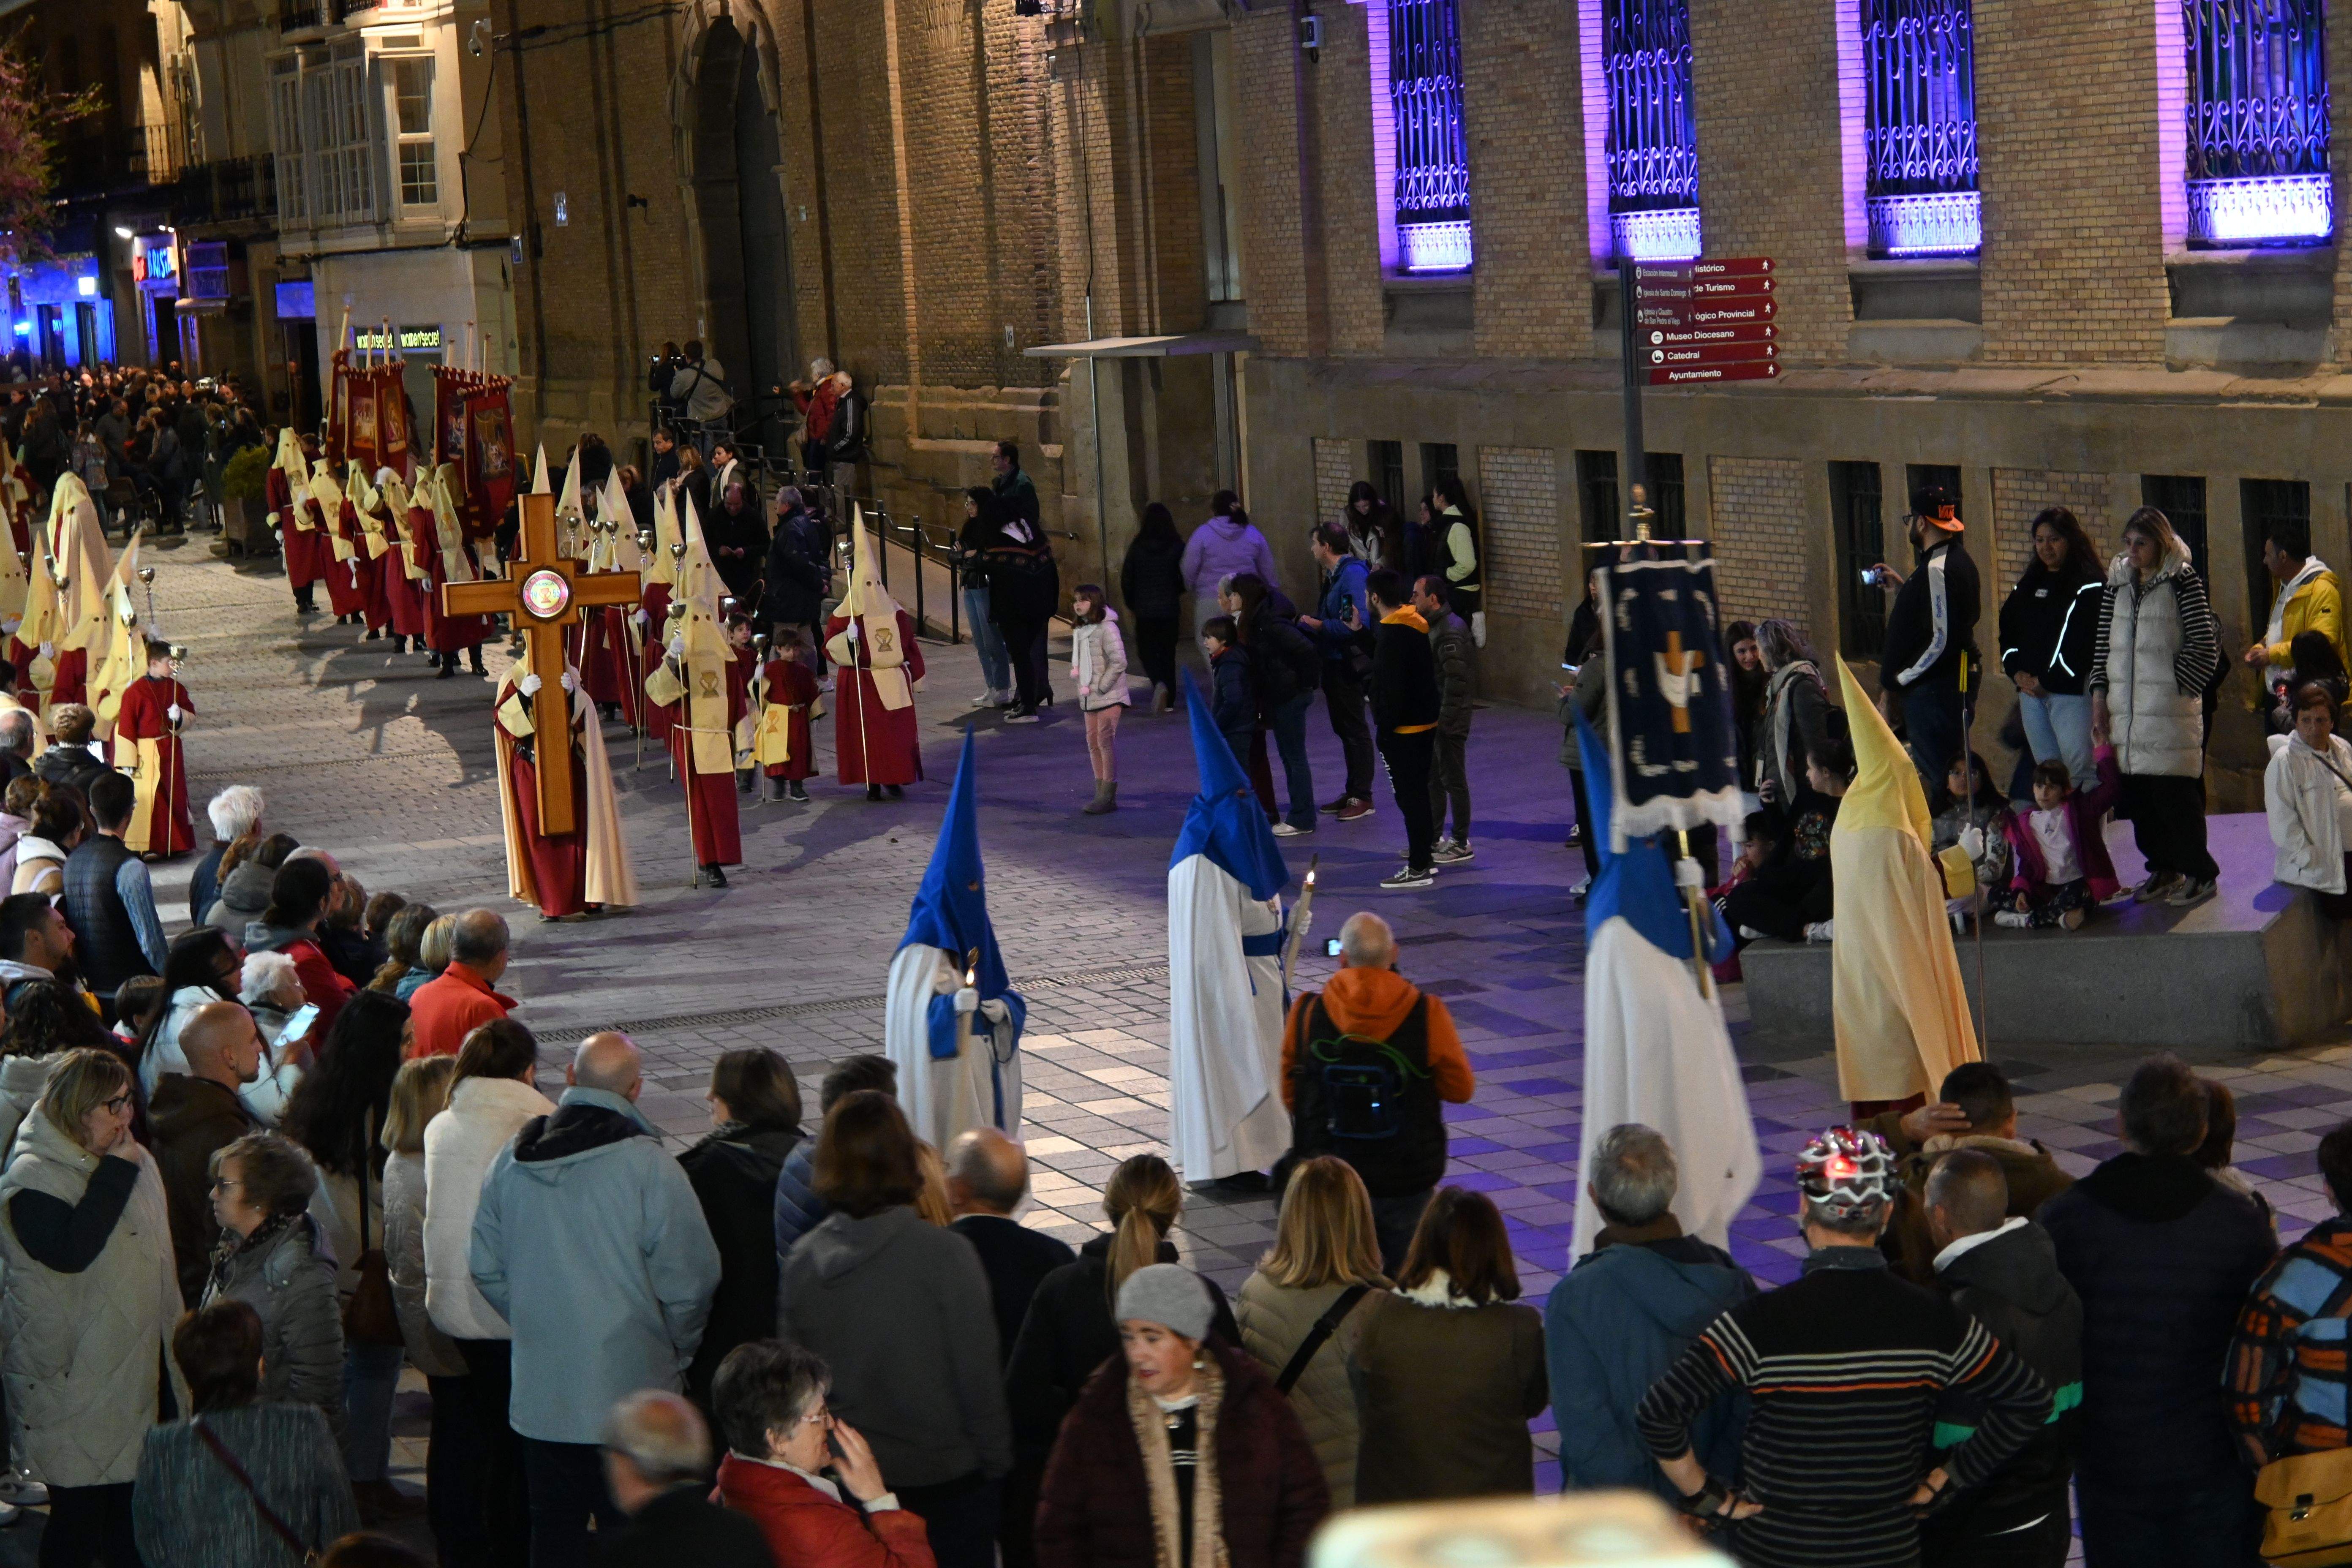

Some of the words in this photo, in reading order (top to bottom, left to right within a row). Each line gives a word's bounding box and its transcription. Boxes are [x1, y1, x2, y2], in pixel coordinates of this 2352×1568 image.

[1705, 283, 1735, 292] Turismo
[1695, 311, 1716, 321] ógico
[1718, 310, 1755, 318] Provincial
[1666, 332, 1692, 341] Museo
[1694, 331, 1734, 339] Diocesano
[1668, 351, 1700, 360] Catedral
[1669, 370, 1722, 381] Ayuntamiento
